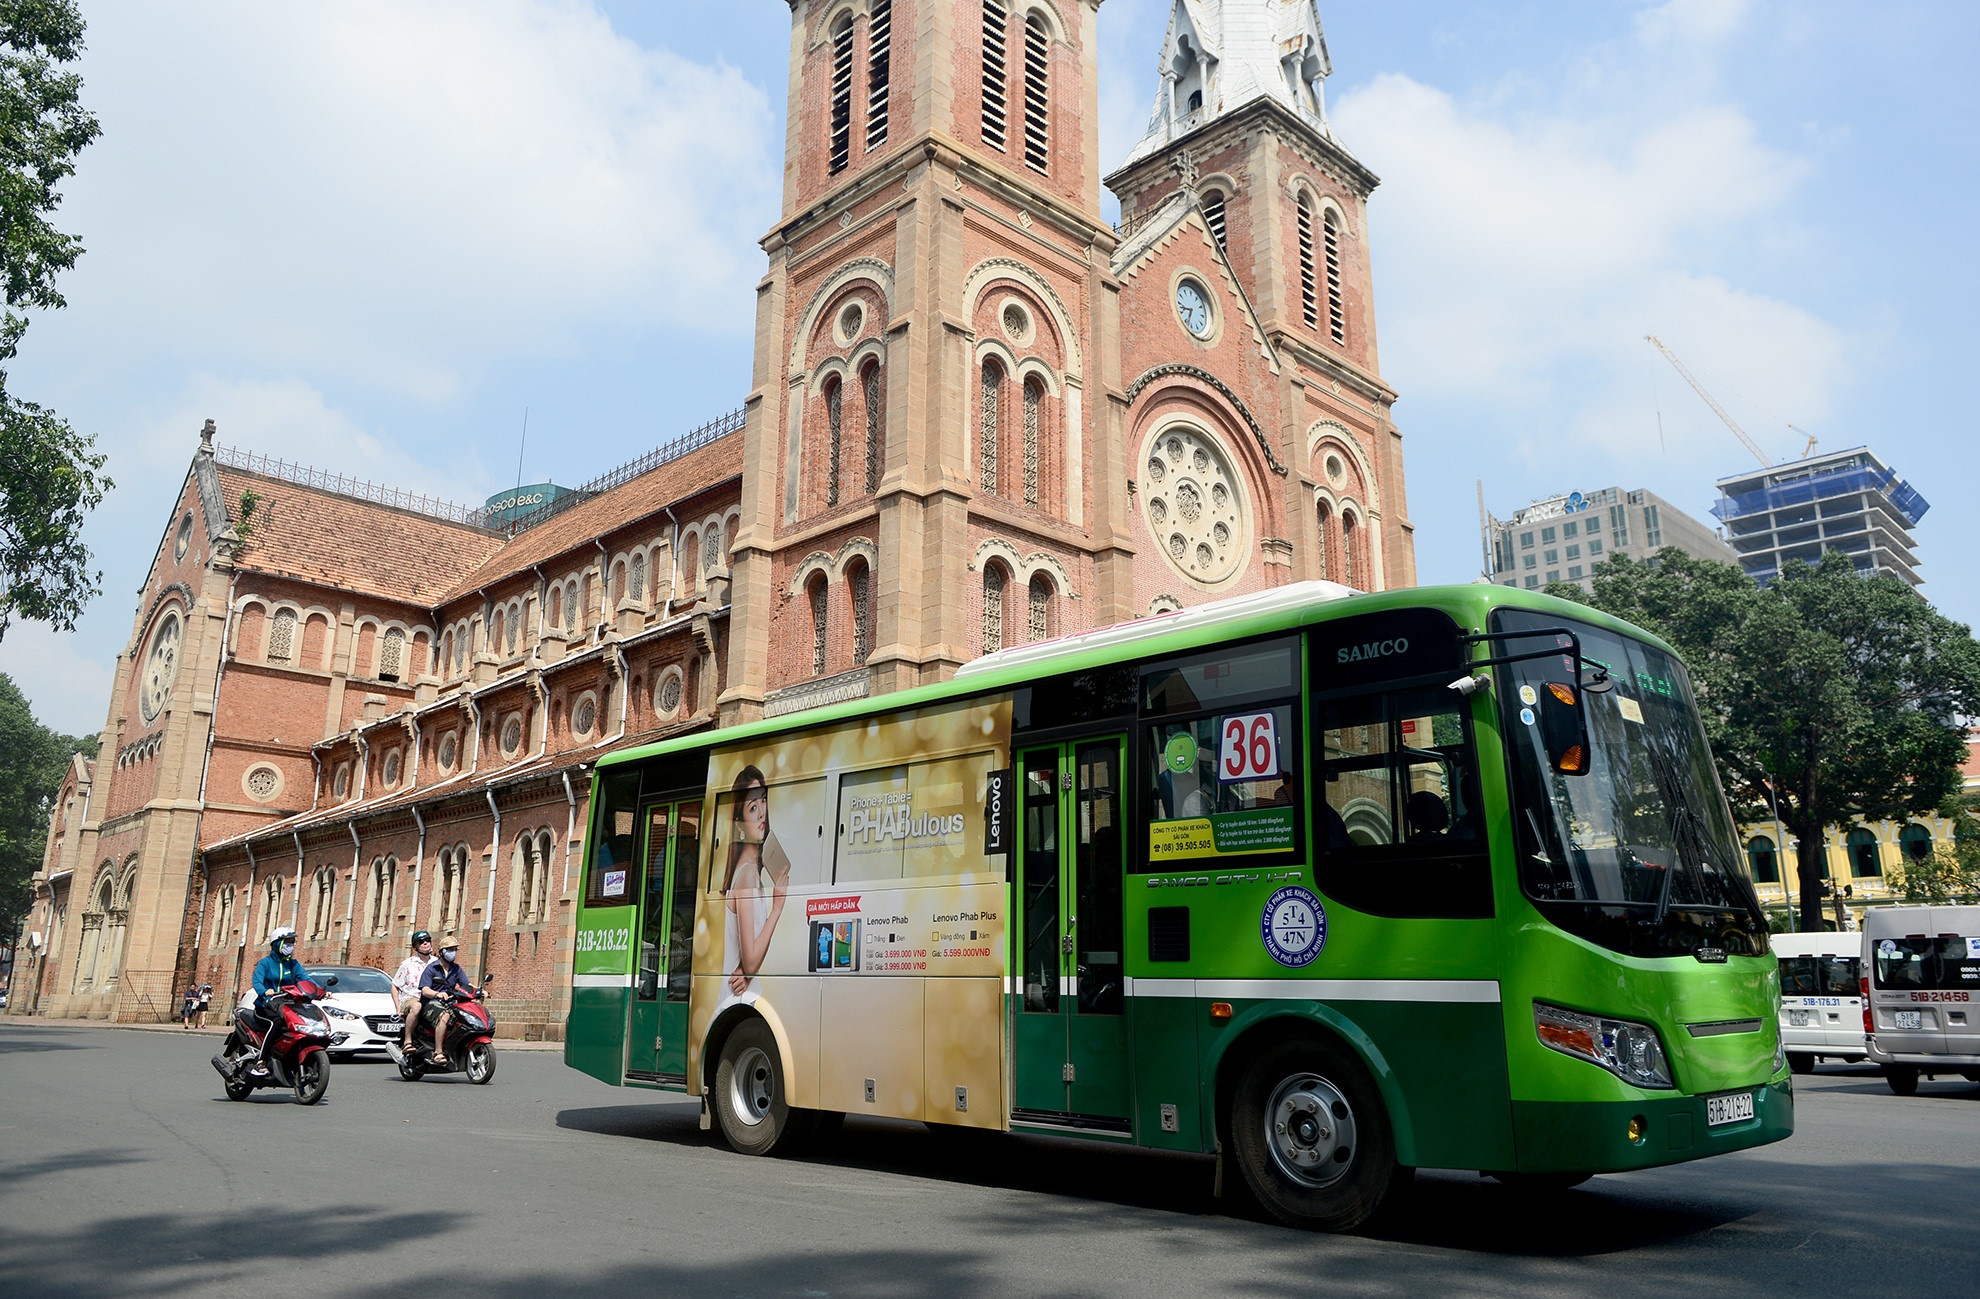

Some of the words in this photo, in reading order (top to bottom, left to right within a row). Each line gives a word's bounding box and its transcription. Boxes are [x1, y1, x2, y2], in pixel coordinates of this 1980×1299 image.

[1338, 638, 1408, 663] SAMCO
[1226, 716, 1270, 776] 36
[991, 777, 1001, 848] Lenovo
[848, 804, 964, 845] PHABulous
[1162, 843, 1174, 853] (08)
[1175, 840, 1211, 851] 39.505.505
[1147, 876, 1210, 888] SAMCO
[1216, 873, 1259, 886] CITY
[1286, 889, 1293, 897] XE
[1294, 889, 1312, 902] KHÁCH
[808, 903, 817, 911] GIÁ
[867, 917, 890, 925] Lenovo
[892, 915, 908, 924] Phab
[932, 914, 958, 922] Lenovo
[960, 912, 979, 921] Phab
[981, 911, 997, 920] Plus
[576, 928, 629, 951] 51B-218.22
[1283, 931, 1306, 944] 47N
[1312, 934, 1324, 953] MINH
[885, 950, 912, 958] 3.699.000
[913, 949, 927, 957] VNĐ
[884, 962, 912, 970] 3.999.000
[913, 962, 927, 970] VNĐ
[1803, 998, 1840, 1006] 51B-176.31
